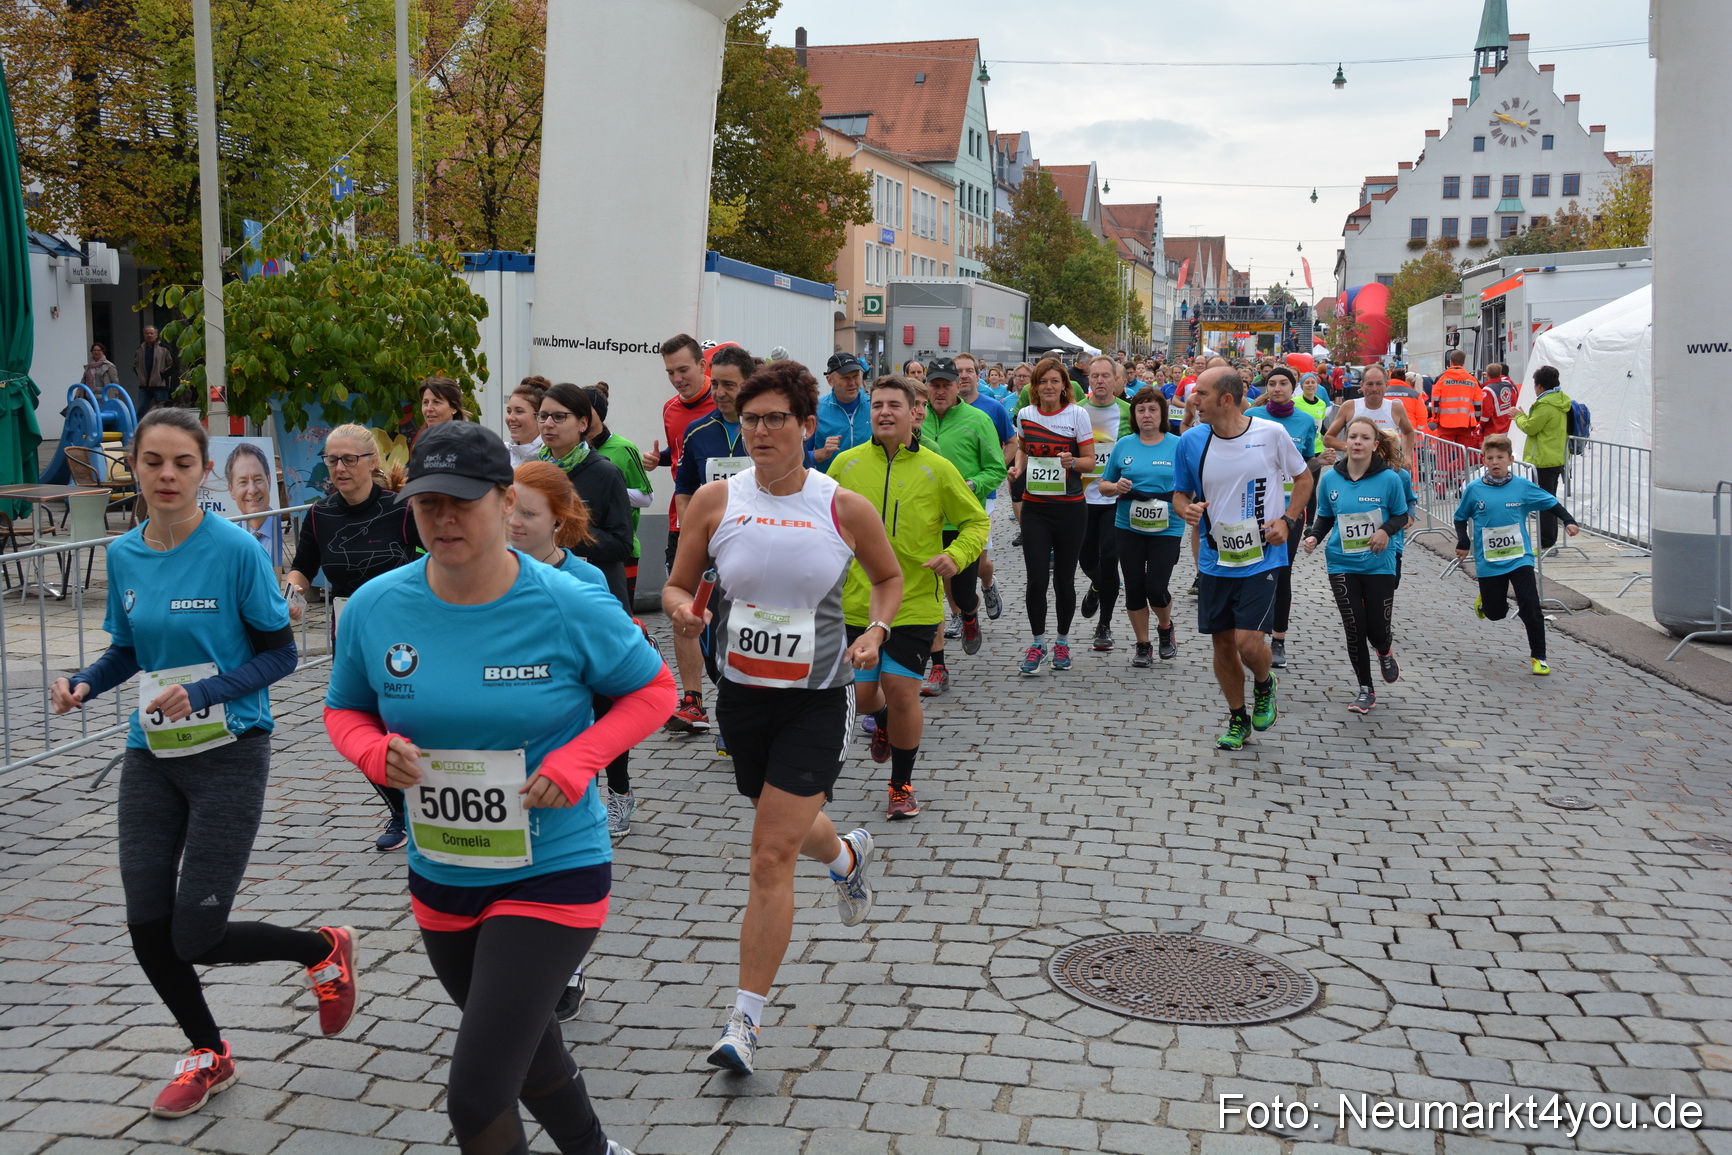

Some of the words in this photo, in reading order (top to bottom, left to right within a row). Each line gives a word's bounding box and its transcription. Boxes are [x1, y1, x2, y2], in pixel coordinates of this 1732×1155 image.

[72, 268, 83, 276] Hut
[92, 268, 108, 276] Mode
[867, 298, 880, 312] D
[1234, 322, 1251, 331] ZIEL
[533, 335, 662, 355] www.bmw-laufsport.d
[1687, 342, 1732, 354] www.
[1032, 468, 1060, 481] 5212
[1135, 506, 1163, 519] 5057
[756, 516, 817, 530] KLEBL
[1346, 522, 1376, 538] 5171
[1222, 532, 1254, 550] 5064
[1488, 535, 1516, 549] 5201
[169, 599, 219, 610] BOCK
[739, 627, 802, 658] 8017
[483, 664, 551, 681] BOCK
[384, 682, 415, 693] PARTL
[176, 732, 193, 742] Lea
[444, 761, 486, 772] BOCK
[420, 785, 507, 823] 5068
[442, 832, 491, 848] Cornelia
